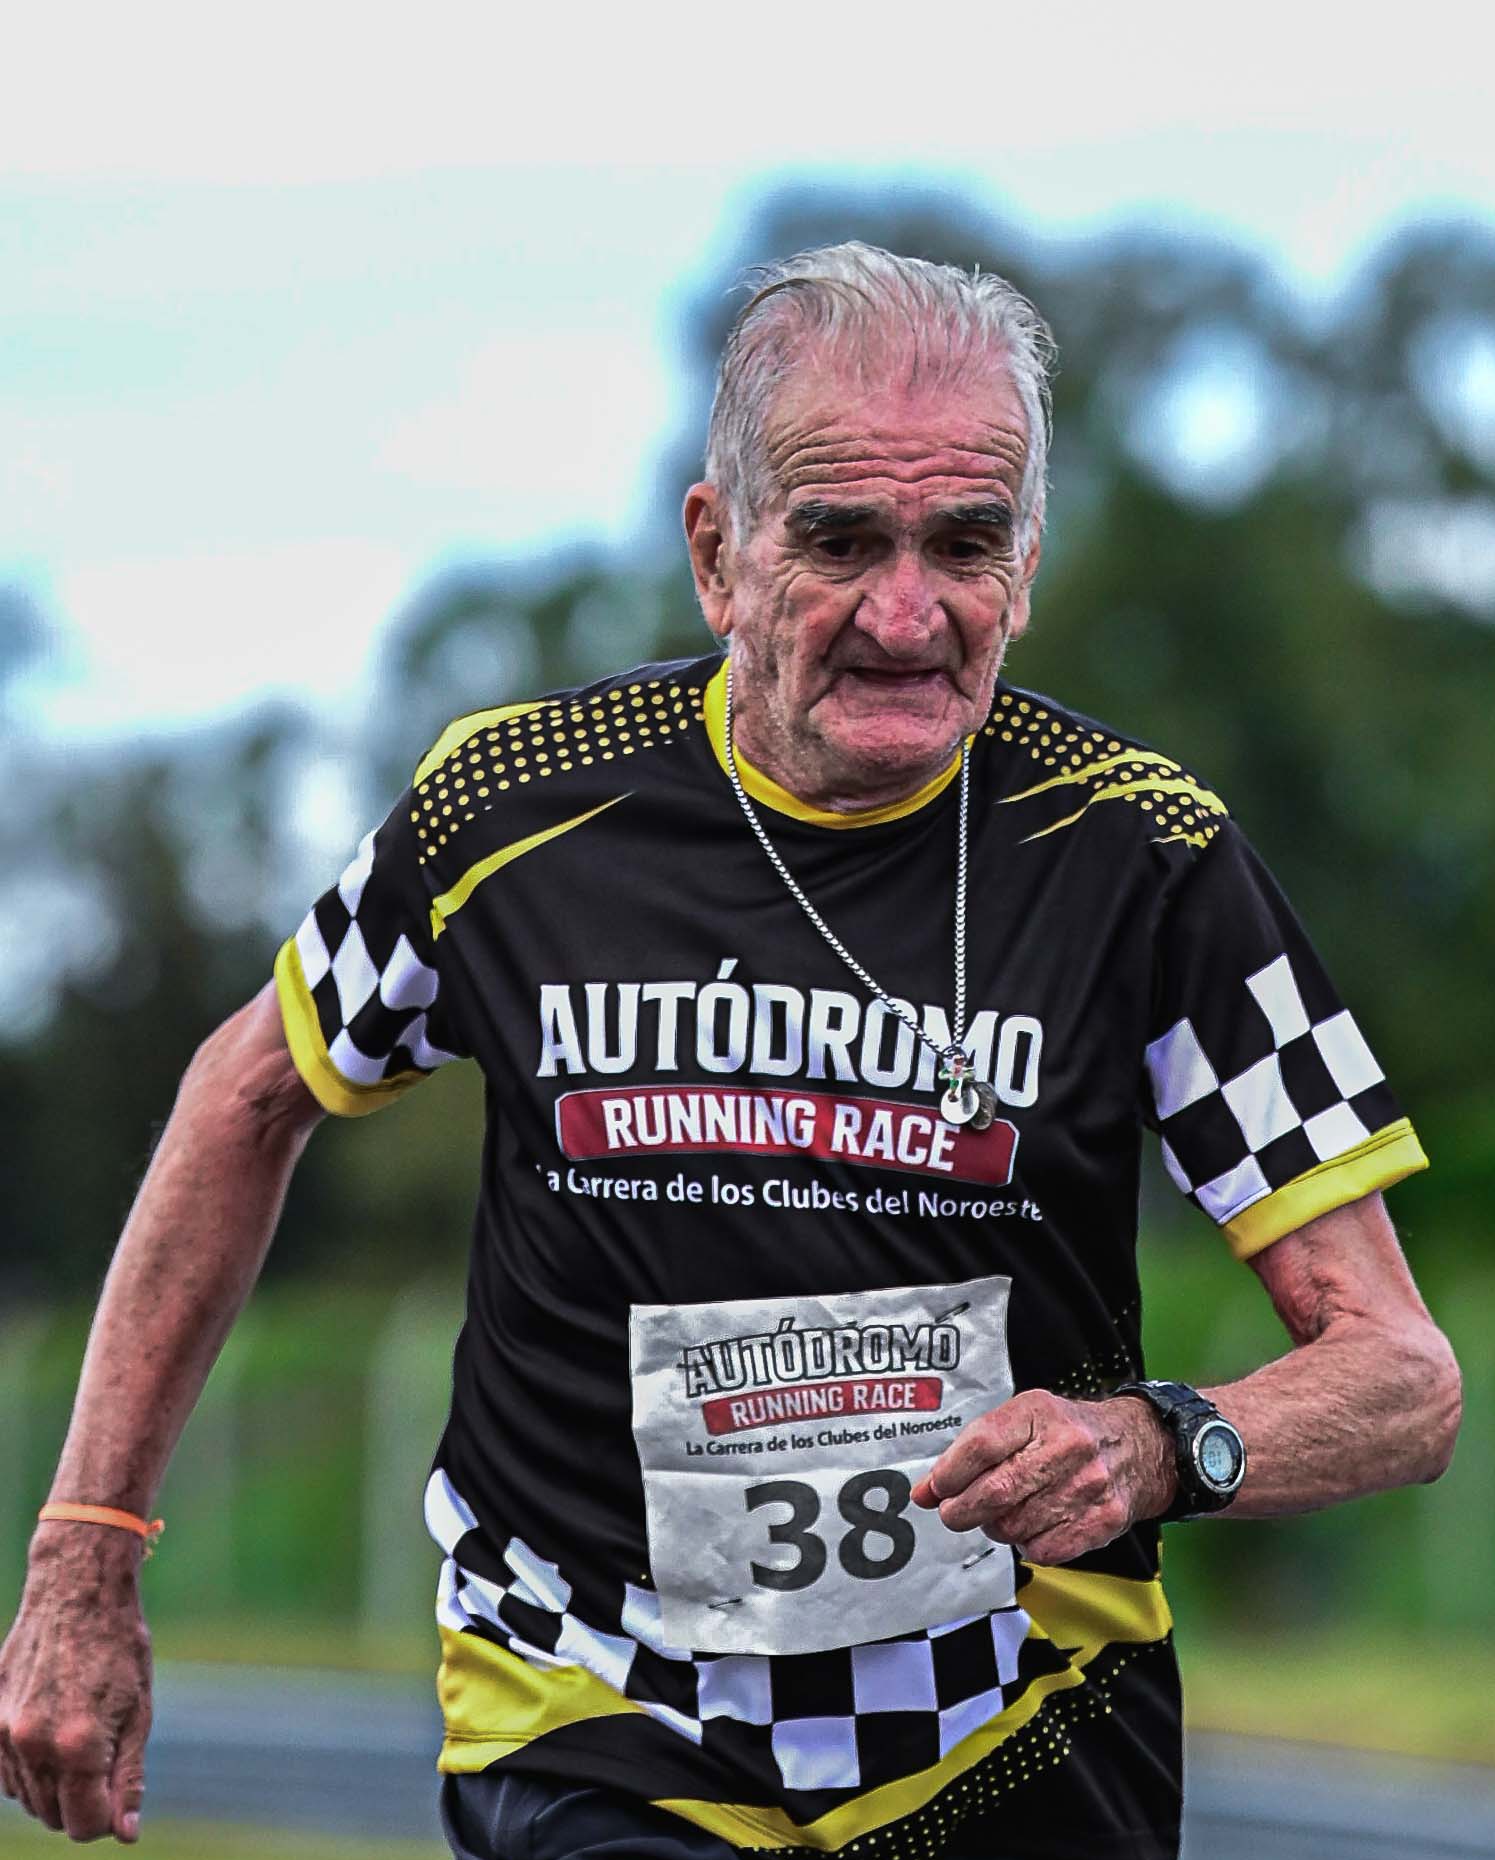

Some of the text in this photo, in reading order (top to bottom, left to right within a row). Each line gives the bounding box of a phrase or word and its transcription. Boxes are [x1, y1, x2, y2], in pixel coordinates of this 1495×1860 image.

[535, 957, 1043, 1108] AUTÓDROMO
[601, 1094, 962, 1172] RUNNING RACE
[666, 1173, 704, 1203] de
[712, 1174, 756, 1206] los
[762, 1179, 860, 1212] Clubes
[865, 1187, 909, 1216] del
[684, 1316, 962, 1397] AUTÓDROMO
[686, 1413, 963, 1457] La Carrera de los Clubes del Noroeste
[729, 1381, 916, 1428] RUNNING RACE
[744, 1468, 915, 1593] 38
